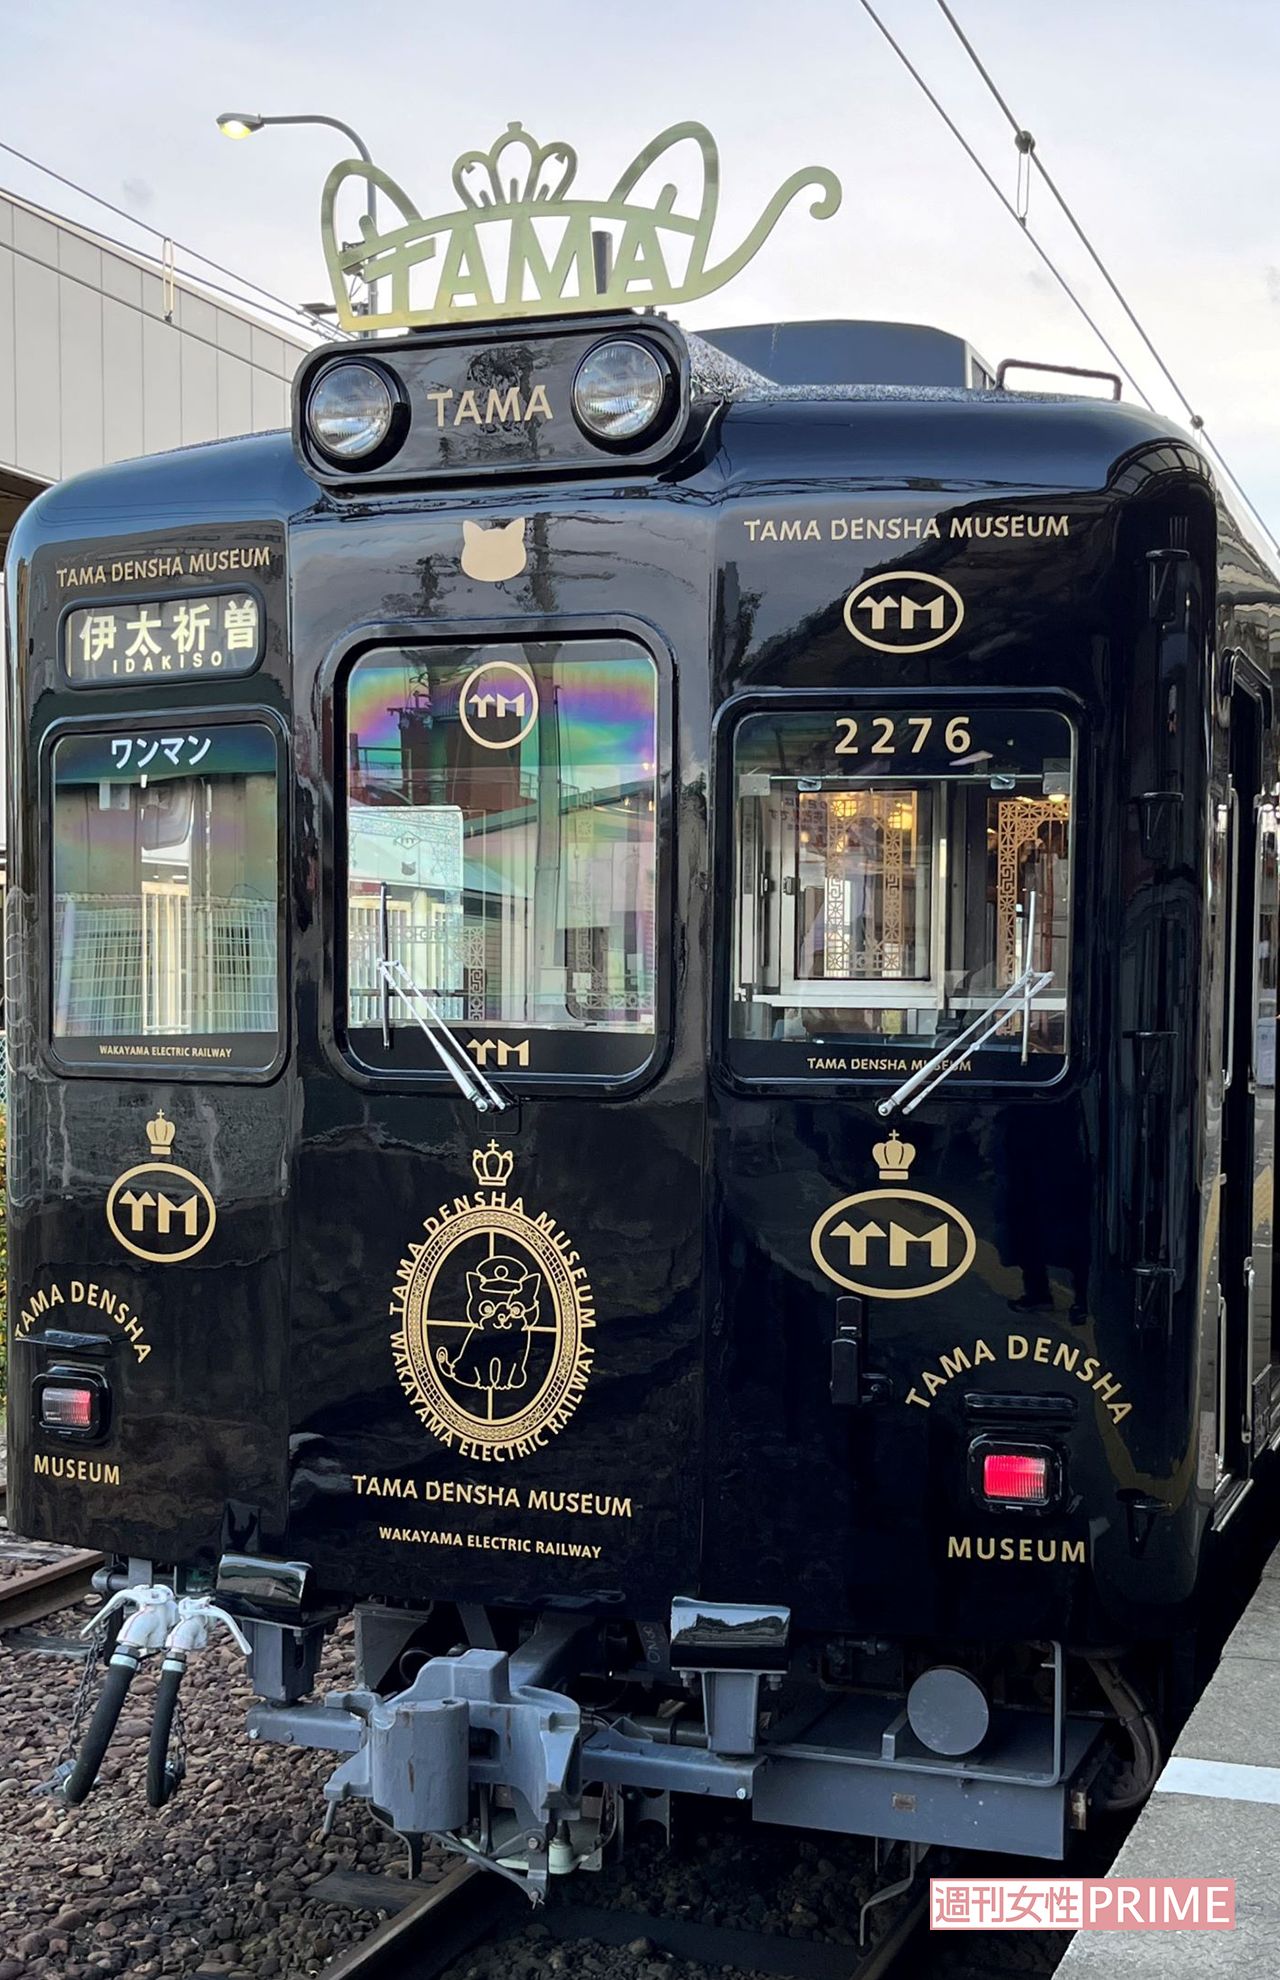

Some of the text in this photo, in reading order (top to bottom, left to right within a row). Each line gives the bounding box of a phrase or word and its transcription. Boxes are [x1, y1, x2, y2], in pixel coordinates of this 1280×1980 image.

[427, 384, 554, 428] TAMA
[744, 514, 1071, 542] TAMA DENSHA MUSEUM
[56, 546, 271, 588] TAMA DENSHA MUSEUM
[79, 599, 258, 662] 伊太祈曽
[857, 594, 945, 630] TM
[112, 650, 223, 675] IDAKISO
[468, 691, 526, 719] TM
[110, 734, 212, 769] ワンマン
[834, 716, 972, 754] 2276
[98, 1044, 233, 1058] WAKAYAMA ELECTRIC RAILWAY
[466, 1038, 529, 1067] TM
[807, 1057, 848, 1070] TAMA
[850, 1058, 908, 1071] DENSHA
[118, 1190, 198, 1236] TM
[389, 1190, 597, 1329] TAMA DENSHA MUSEUM
[829, 1220, 949, 1268] TM
[14, 1280, 152, 1364] TAMA DENSHA
[389, 1331, 595, 1462] WAKAYAMA ELECTRIC RAILWAY
[905, 1334, 1134, 1425] TAMA DENSHA
[34, 1453, 121, 1486] MUSEUM
[352, 1474, 633, 1517] TAMA DENSHA MUSEUM
[378, 1526, 602, 1559] WAKAYAMA ELECTRIC RAILWAY
[947, 1536, 1086, 1564] MUSEUM
